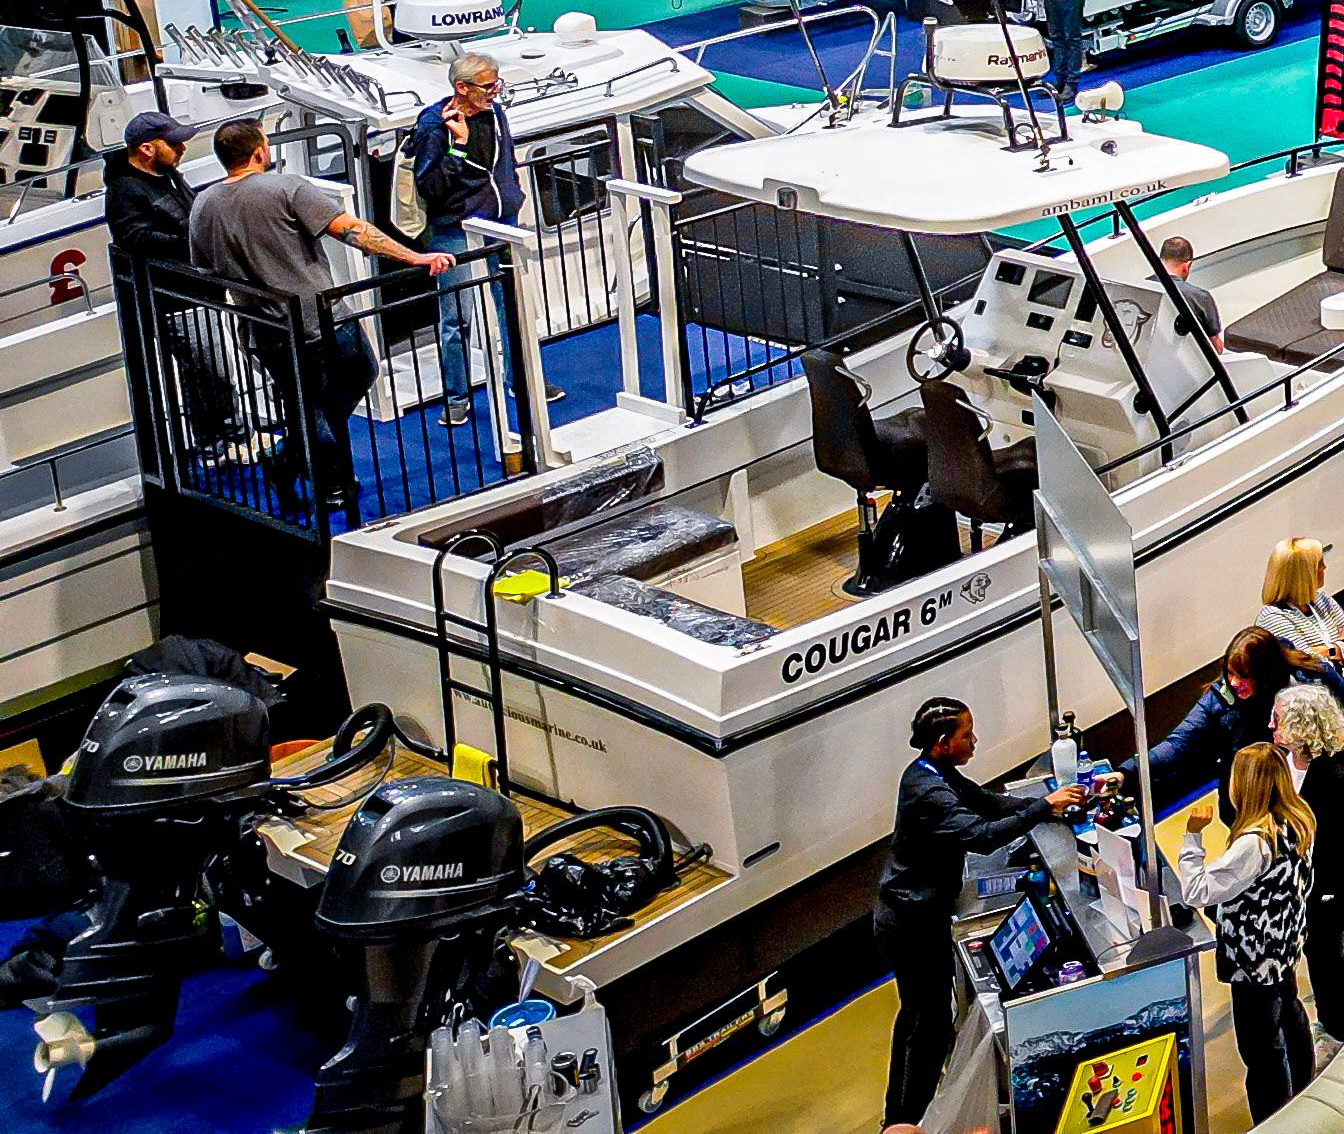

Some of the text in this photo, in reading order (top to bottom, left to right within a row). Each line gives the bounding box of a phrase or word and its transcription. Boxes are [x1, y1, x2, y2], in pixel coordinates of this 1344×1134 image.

[781, 606, 912, 686] COUGAR
[81, 738, 100, 754] 70
[143, 751, 208, 771] YAMAHA
[336, 849, 356, 866] 70
[401, 861, 465, 881] YAMAHA
